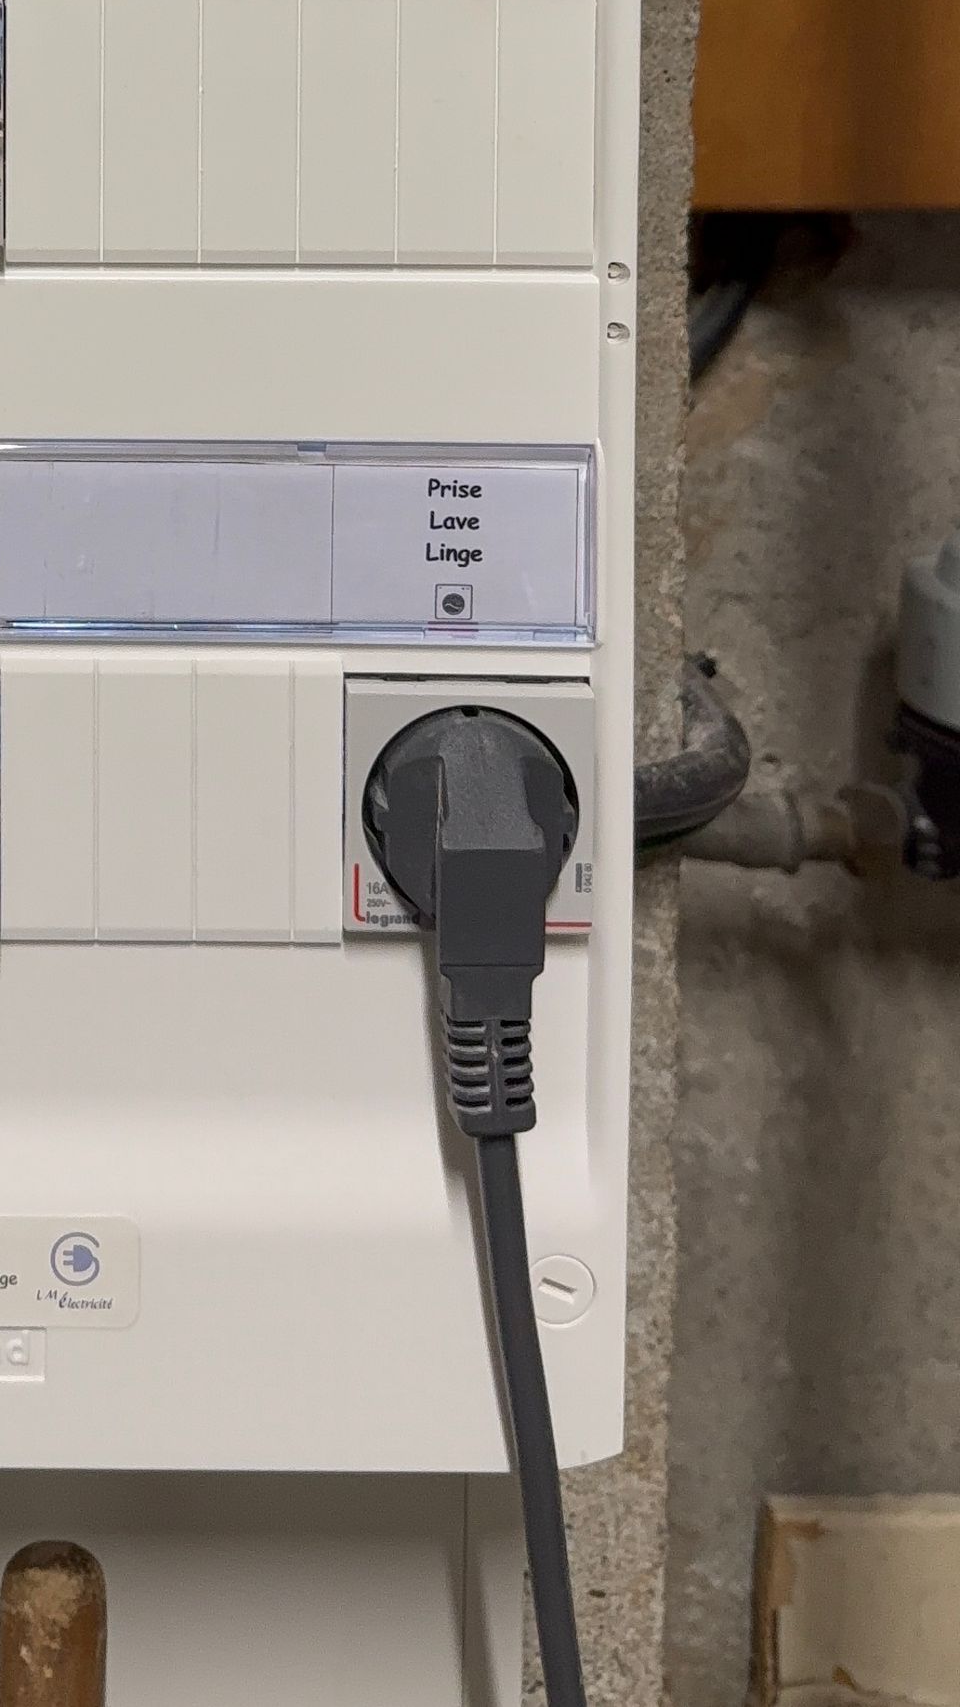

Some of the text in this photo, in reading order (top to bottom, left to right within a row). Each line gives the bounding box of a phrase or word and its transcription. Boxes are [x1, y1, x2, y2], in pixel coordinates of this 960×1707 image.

[428, 479, 482, 498] Prise
[430, 511, 480, 530] Lave
[426, 543, 483, 567] Linge
